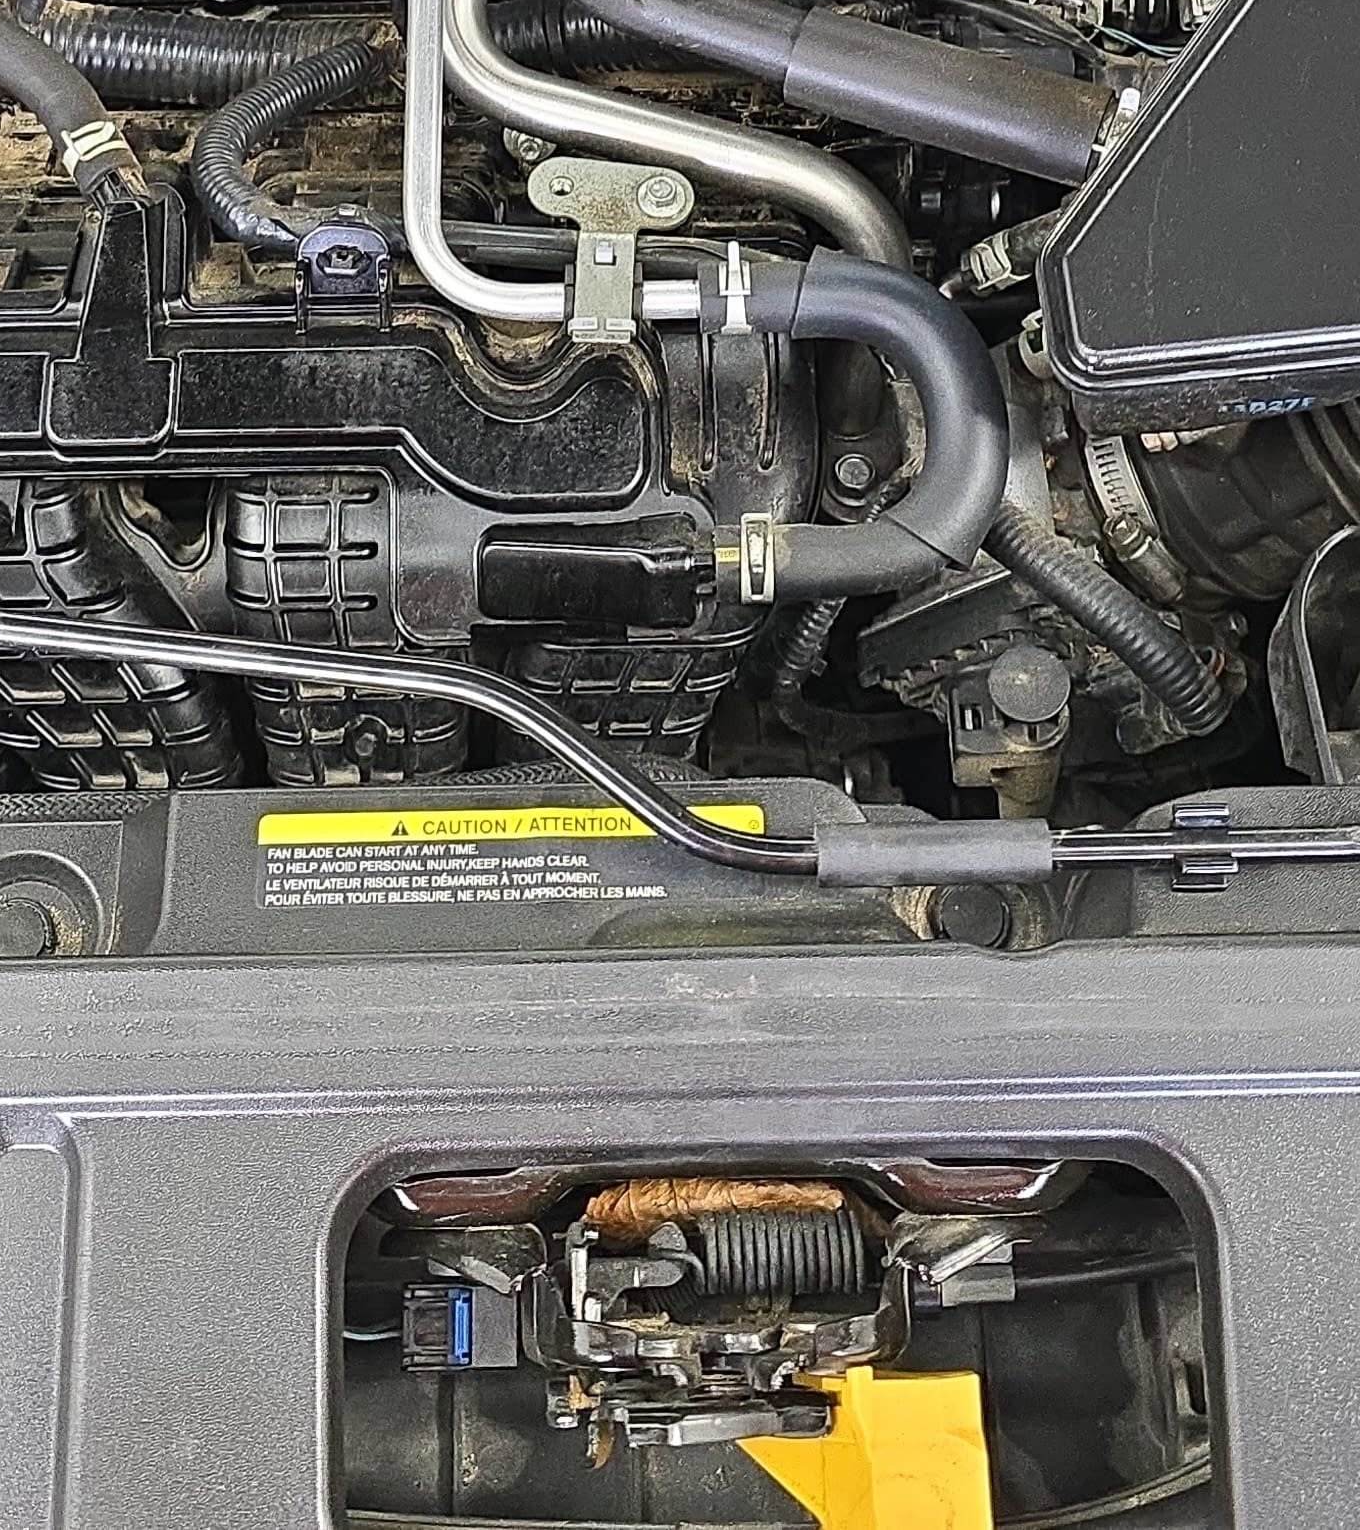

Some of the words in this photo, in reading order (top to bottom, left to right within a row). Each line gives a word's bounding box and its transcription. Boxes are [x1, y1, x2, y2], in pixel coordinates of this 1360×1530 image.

[423, 819, 507, 835] CAUTION
[529, 817, 632, 832] ATTENTION
[267, 847, 291, 859] FAN
[293, 846, 334, 859] BLADE
[336, 846, 363, 857] CAN
[365, 845, 402, 857] START
[403, 845, 420, 856] AT
[421, 845, 447, 856] ANY
[448, 844, 479, 855] TIME.
[267, 863, 284, 875] TO
[286, 862, 317, 874] HELP
[320, 861, 357, 873] AVOID
[359, 860, 425, 872] PERSONAL
[502, 857, 545, 869] HANDS
[266, 879, 281, 891] LE
[283, 878, 361, 891] VENTILATEUR
[364, 876, 410, 889] RISQUE
[412, 876, 429, 887] DE
[431, 872, 503, 887] DÉMARRER
[502, 871, 510, 885] À
[512, 872, 543, 885] TOUT
[545, 872, 601, 884] MOMENT.
[265, 894, 301, 906] POUR
[303, 891, 344, 905] ÉVITER
[346, 892, 386, 904] TOUTE
[388, 890, 455, 903] BLESSURE,
[457, 890, 474, 901] NE
[476, 889, 501, 901] PAS
[503, 889, 521, 900] EN
[522, 886, 598, 900] APPROCHER
[600, 886, 624, 898] LES
[625, 886, 668, 899] MAINS.
